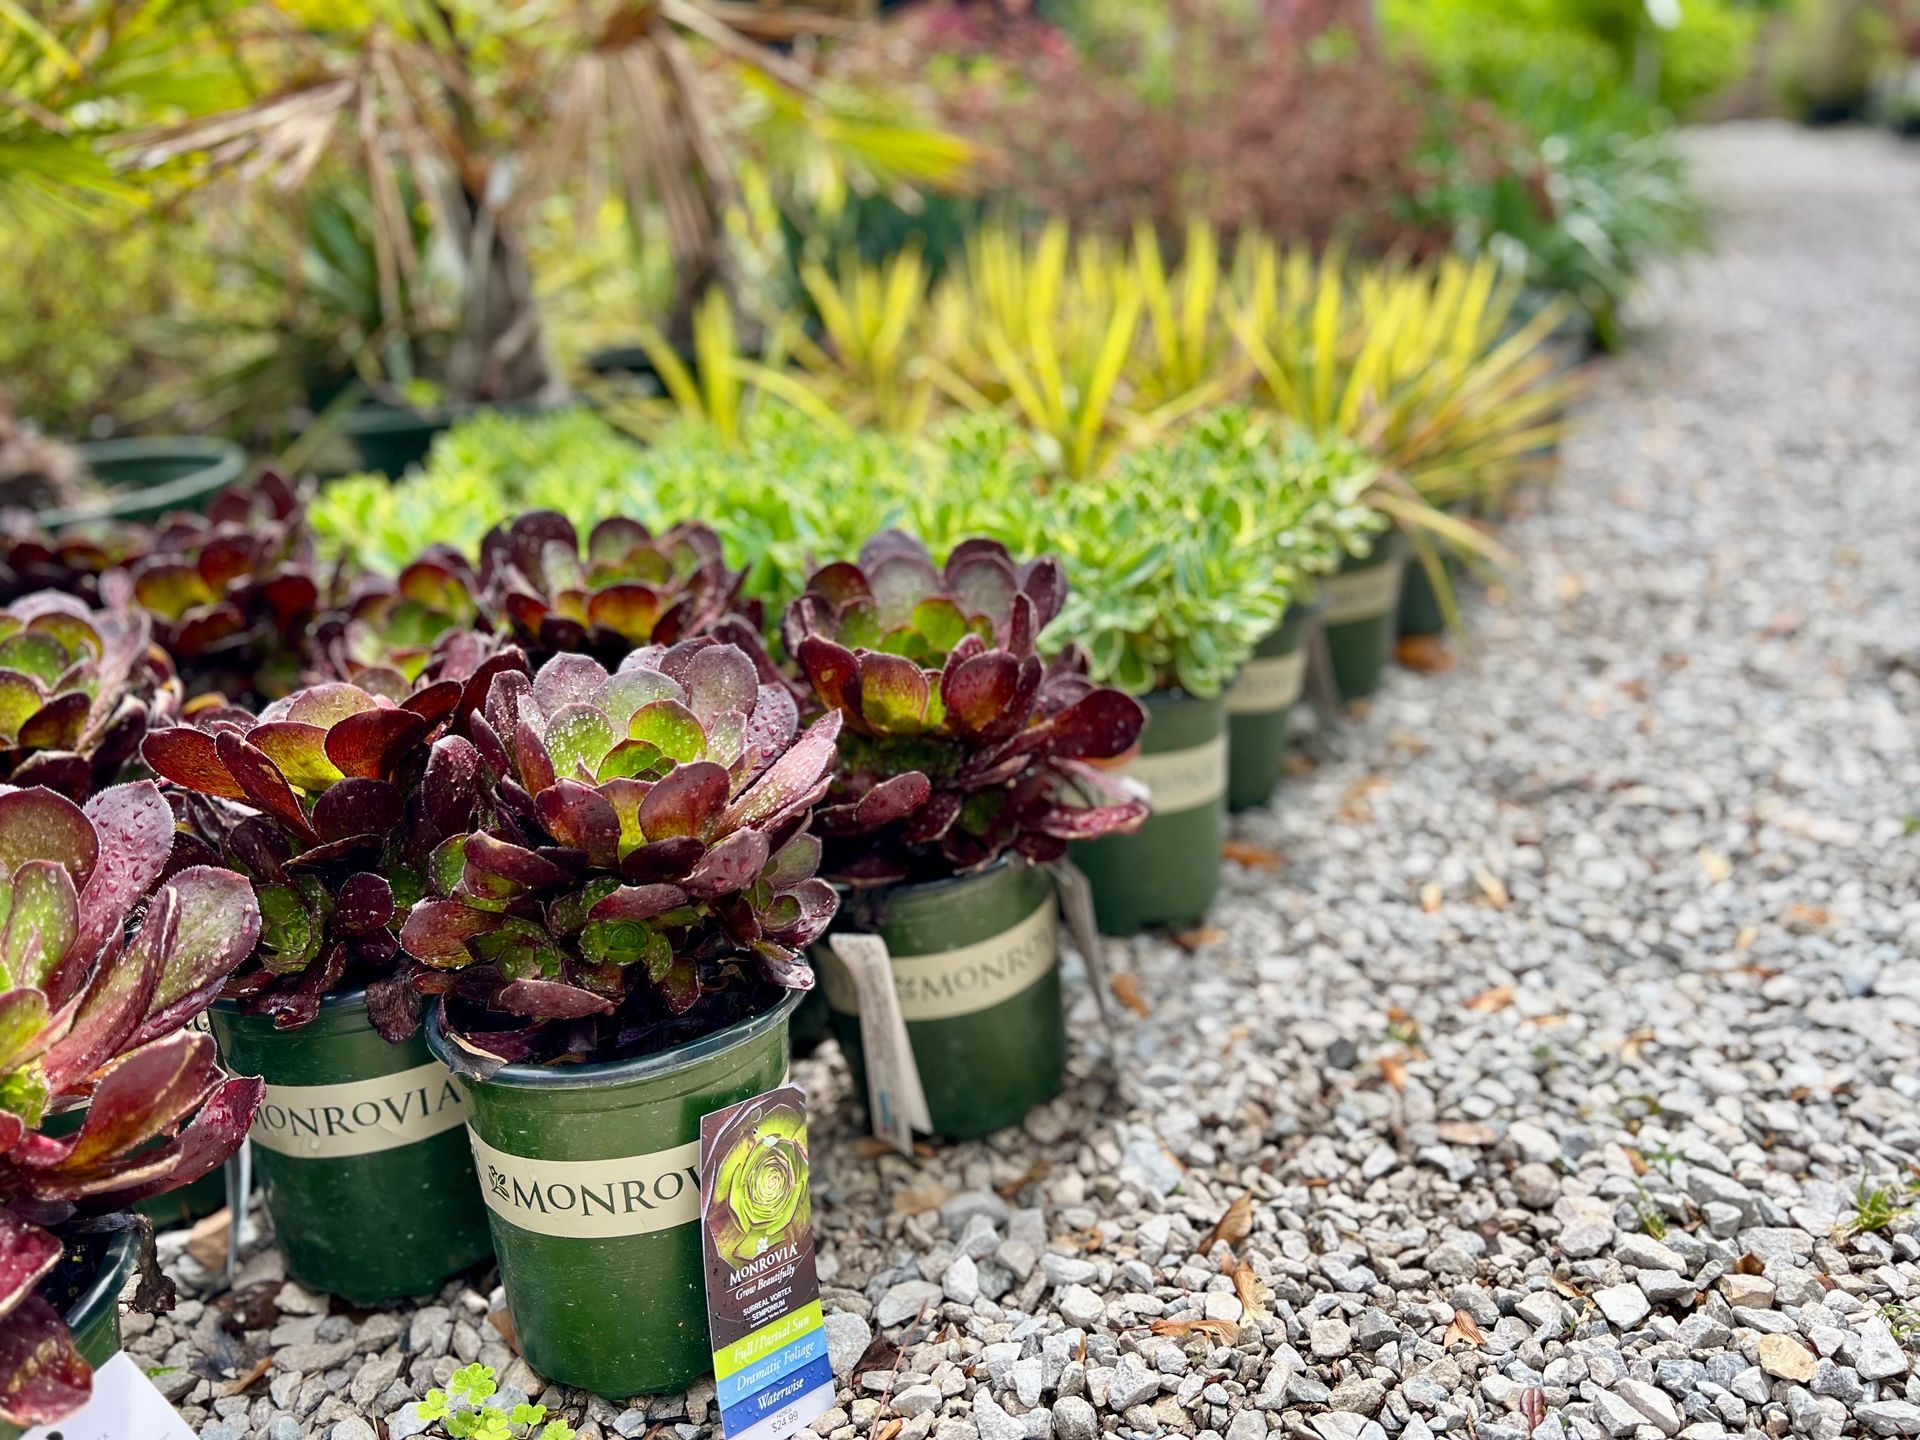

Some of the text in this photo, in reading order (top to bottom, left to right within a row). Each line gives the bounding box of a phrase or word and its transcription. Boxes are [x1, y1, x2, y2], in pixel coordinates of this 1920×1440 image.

[729, 1242, 798, 1287] MONROVIA
[735, 1263, 796, 1301] Grow Beautifully
[742, 1298, 770, 1317] SURREAL
[769, 1286, 793, 1302] VORTEX
[751, 1298, 786, 1321] SEMPONIUM
[791, 1316, 810, 1331] Sun
[737, 1341, 815, 1392] Dramatic Foliage
[757, 1377, 804, 1410] Waterwise
